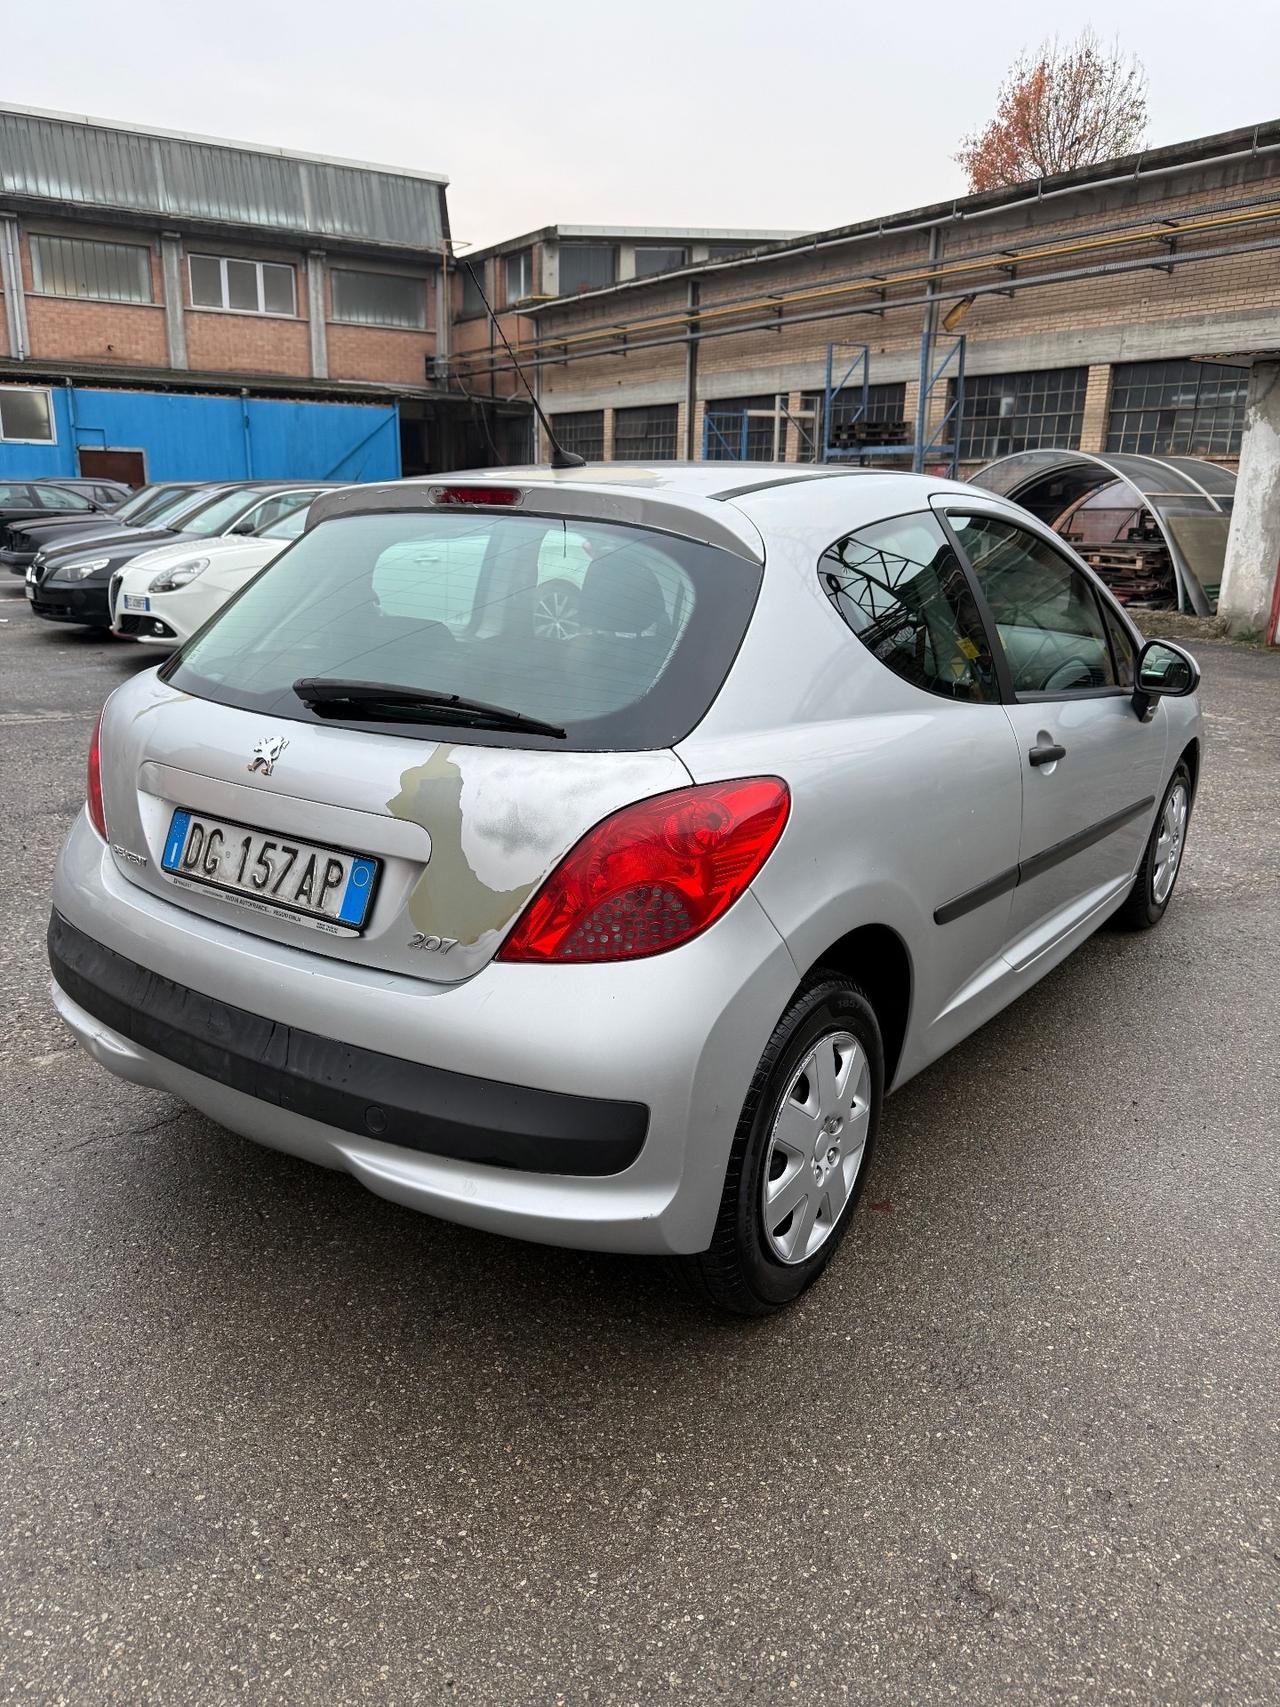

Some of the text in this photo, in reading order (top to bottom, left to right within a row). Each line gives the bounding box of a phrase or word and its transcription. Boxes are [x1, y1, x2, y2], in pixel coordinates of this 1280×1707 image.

[183, 822, 225, 875] DG
[237, 836, 345, 908] 157AP
[408, 931, 458, 955] 207
